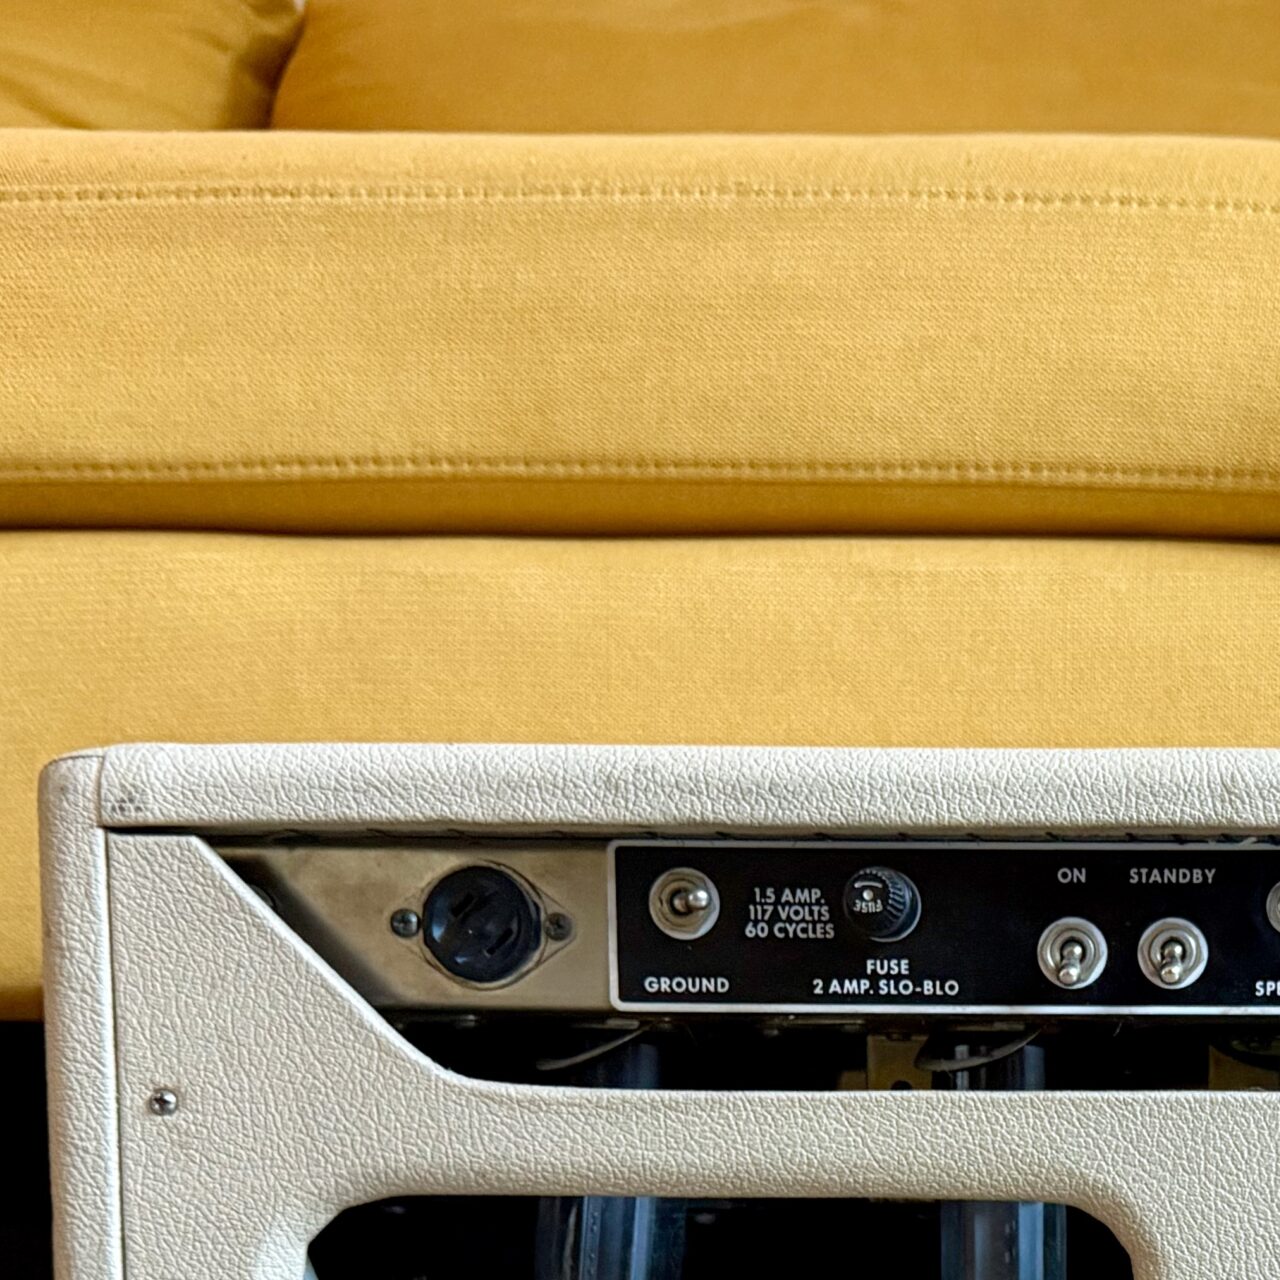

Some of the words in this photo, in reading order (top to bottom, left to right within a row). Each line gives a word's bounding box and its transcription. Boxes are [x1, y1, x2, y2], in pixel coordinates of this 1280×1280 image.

[1057, 867, 1087, 884] ON
[1129, 867, 1216, 884] STANDBY
[753, 887, 776, 904] 1.5
[780, 887, 825, 904] AMP.
[748, 904, 774, 921] 117
[777, 904, 830, 922] VOLTS
[744, 921, 769, 938] 60
[773, 921, 835, 939] CYCLES
[866, 958, 910, 975] FUSE
[643, 976, 730, 993] GROUND
[812, 978, 824, 995] 2
[828, 978, 874, 995] AMP.
[878, 978, 960, 996] SLO-BLO
